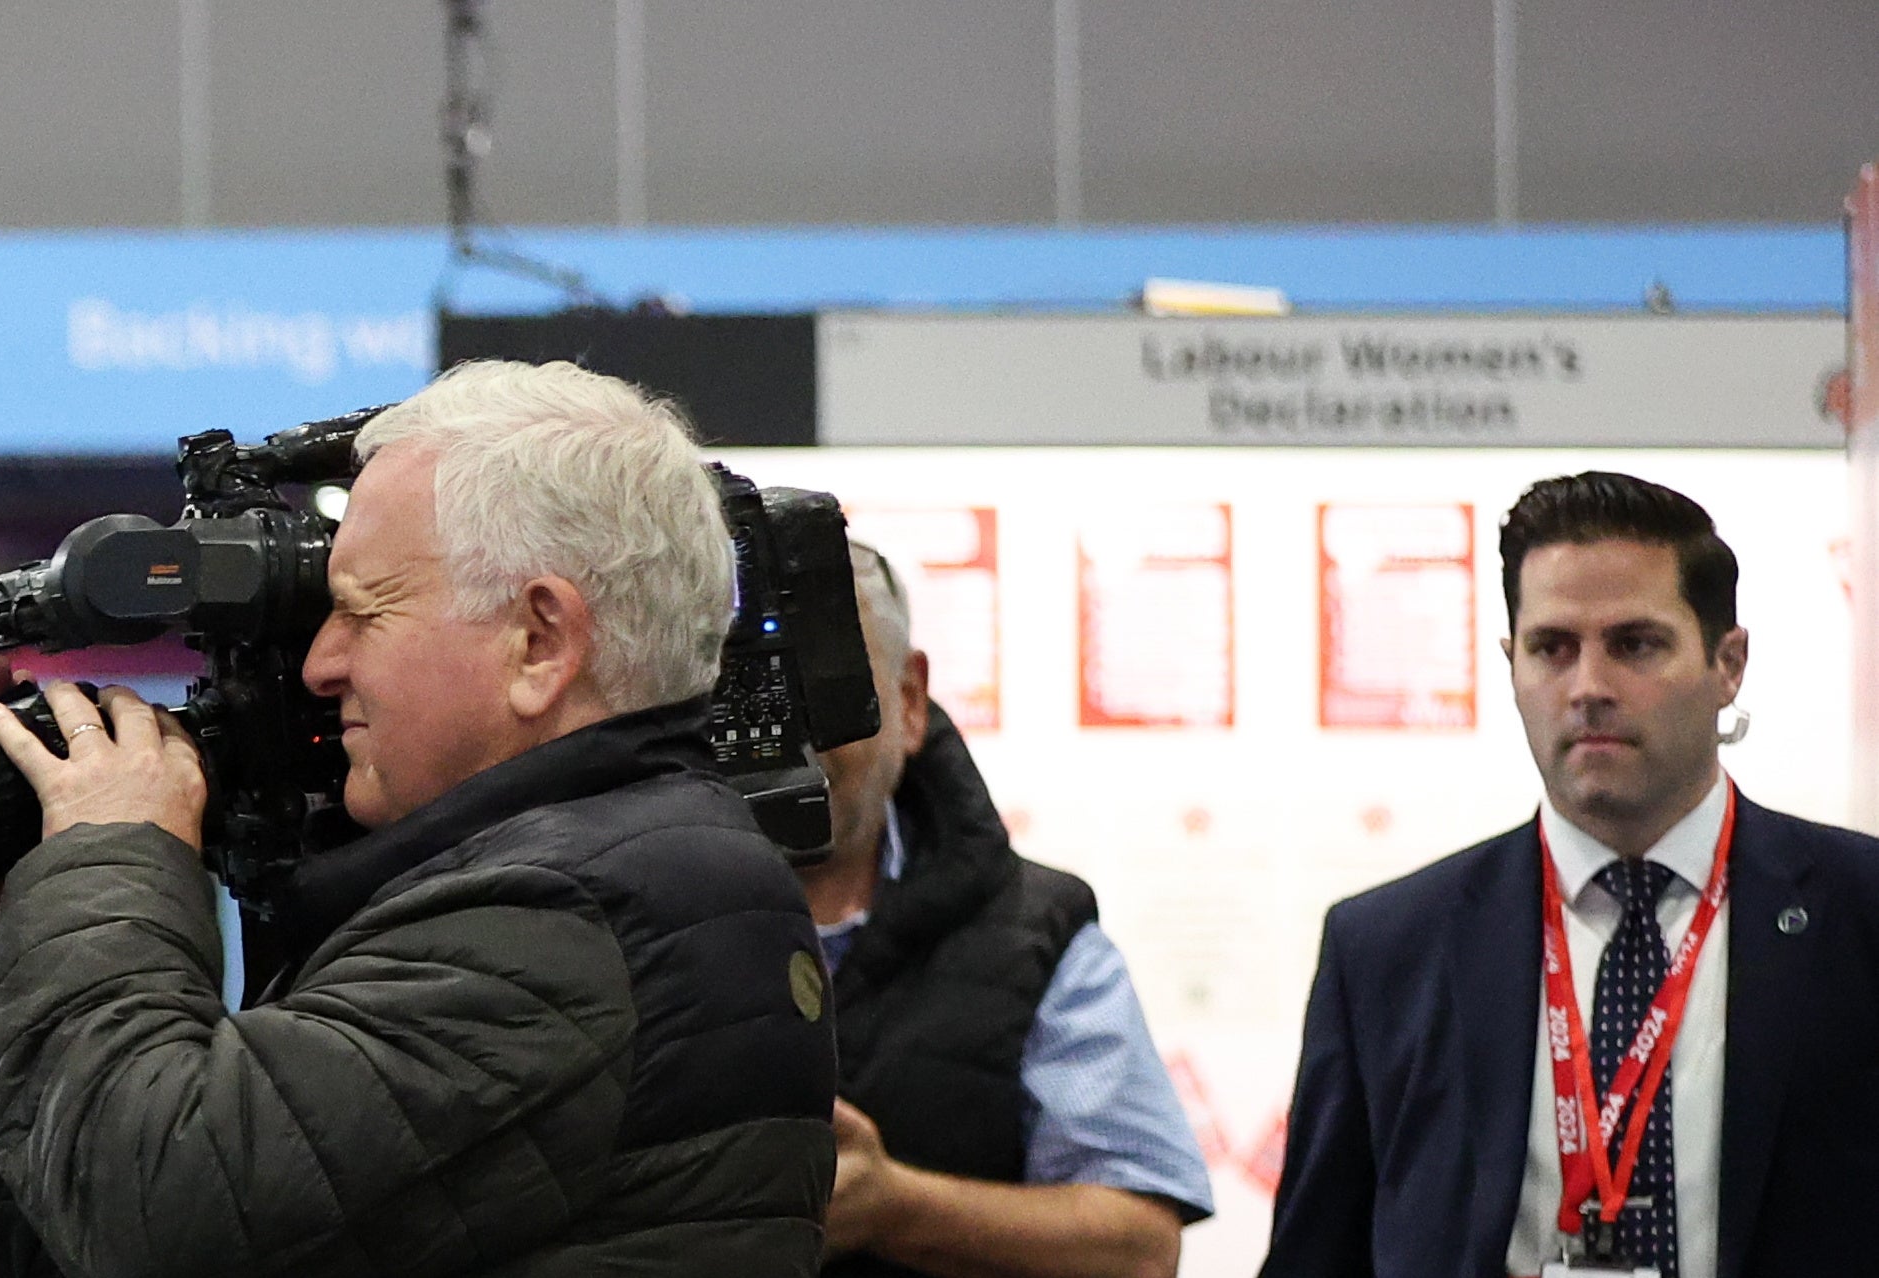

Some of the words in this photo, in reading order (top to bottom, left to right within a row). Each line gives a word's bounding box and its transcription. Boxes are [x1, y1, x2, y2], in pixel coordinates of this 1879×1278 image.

[1141, 333, 1324, 384] Labour
[1344, 331, 1585, 384] Women's
[1207, 388, 1518, 433] Declaration
[1547, 1004, 1572, 1062] 2024
[1628, 1004, 1669, 1066] 2024
[1556, 1095, 1580, 1155] 2024
[1598, 1092, 1625, 1148] 024
